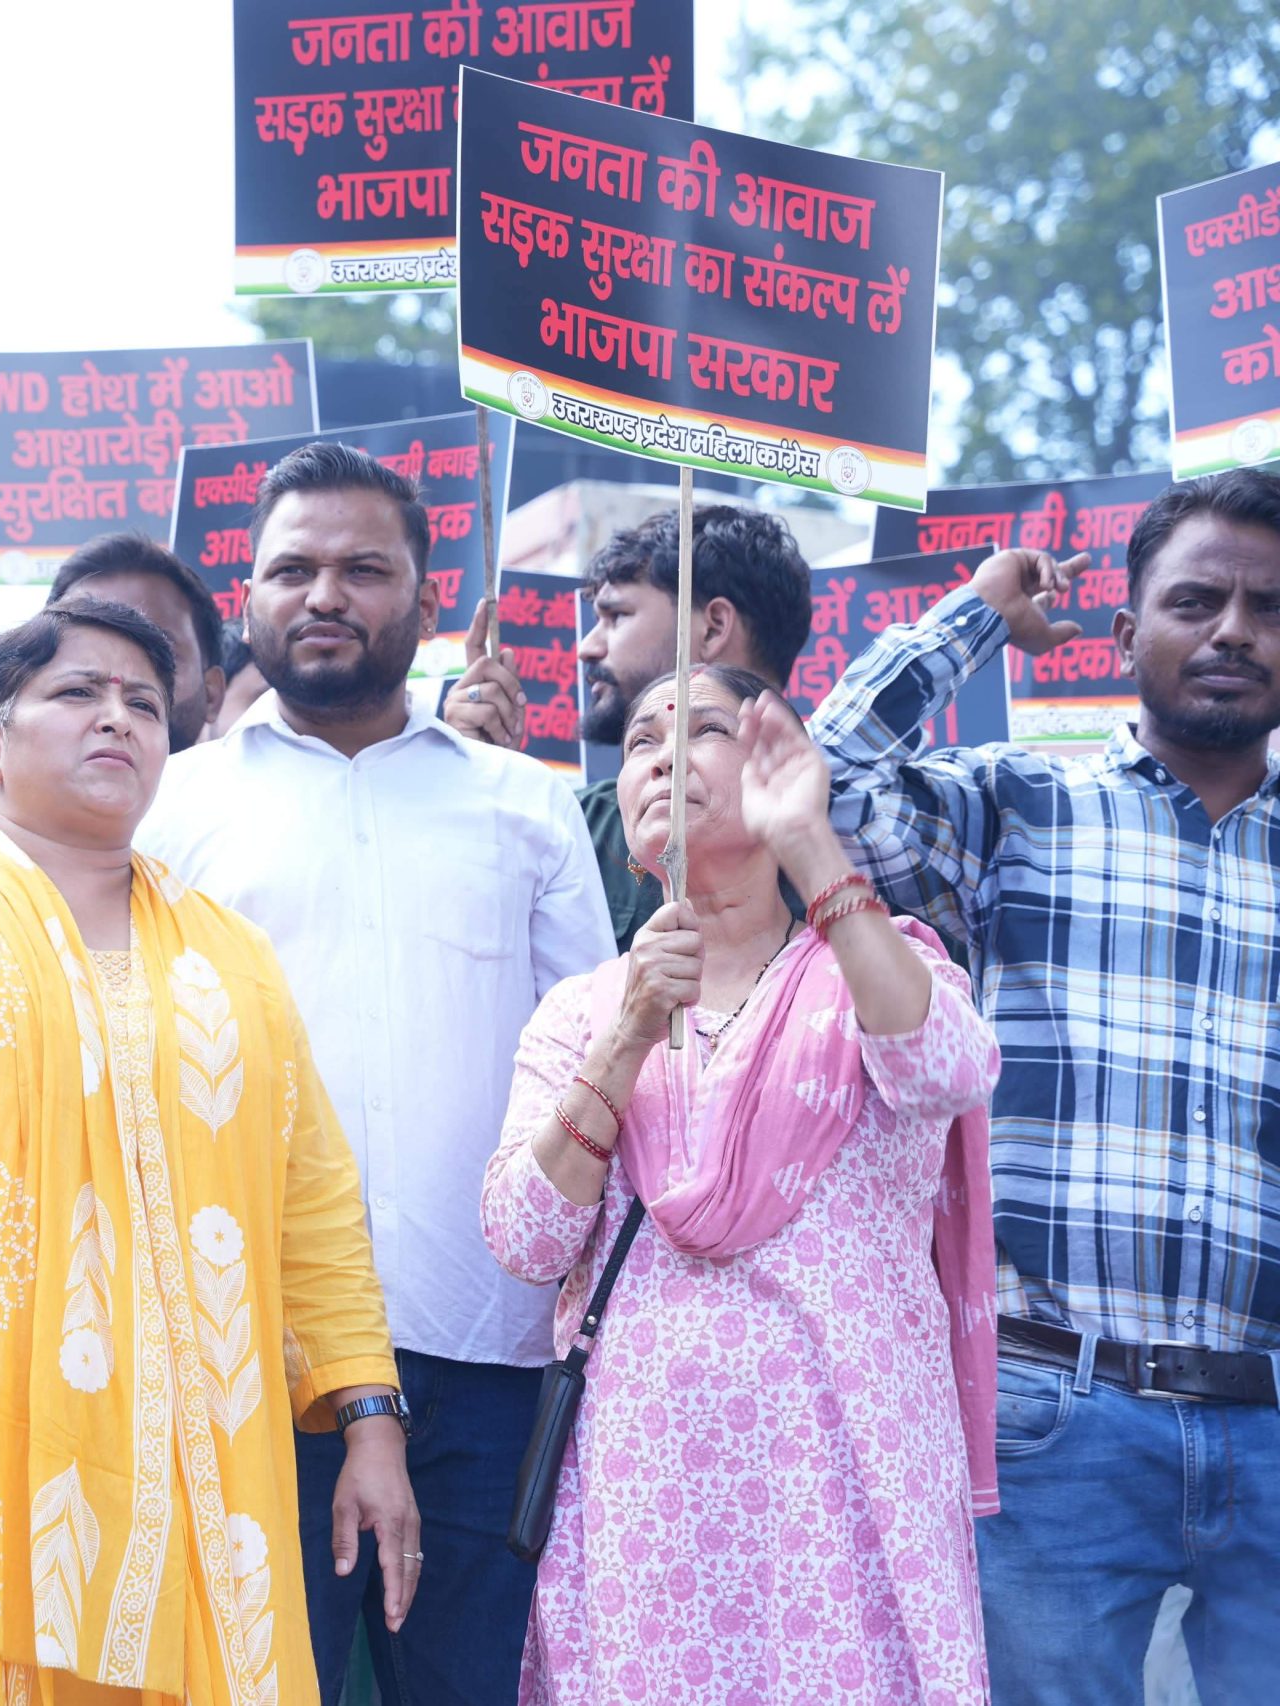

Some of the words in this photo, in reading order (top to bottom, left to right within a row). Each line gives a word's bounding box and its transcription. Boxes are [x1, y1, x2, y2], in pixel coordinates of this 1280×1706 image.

[287, 12, 414, 67] जनता
[421, 0, 484, 59] की
[491, 0, 636, 57] आवाज
[254, 91, 348, 156] सड़क
[352, 85, 446, 162] सुरक्षा
[316, 167, 453, 222] भाजपा
[517, 120, 649, 203] जनता
[656, 139, 722, 218] की
[728, 172, 877, 250] आवाज
[331, 256, 419, 284] उत्तराखण्ड
[480, 191, 575, 269] सड़क
[580, 218, 677, 301] सुरक्षा
[684, 243, 737, 299] का
[742, 243, 861, 325] संकल्प
[867, 265, 911, 335] लें
[58, 360, 139, 417] होश
[147, 358, 189, 408] में
[194, 354, 294, 410] आओ
[539, 297, 678, 381] भाजपा
[687, 333, 841, 414] सरकार
[13, 410, 183, 476] आशारोड़ी
[552, 393, 639, 442] उत्तराखण्ड
[639, 415, 689, 448] प्रदेश
[688, 425, 754, 463] महिला
[754, 438, 821, 478] कांग्रेस
[1018, 491, 1068, 552] की
